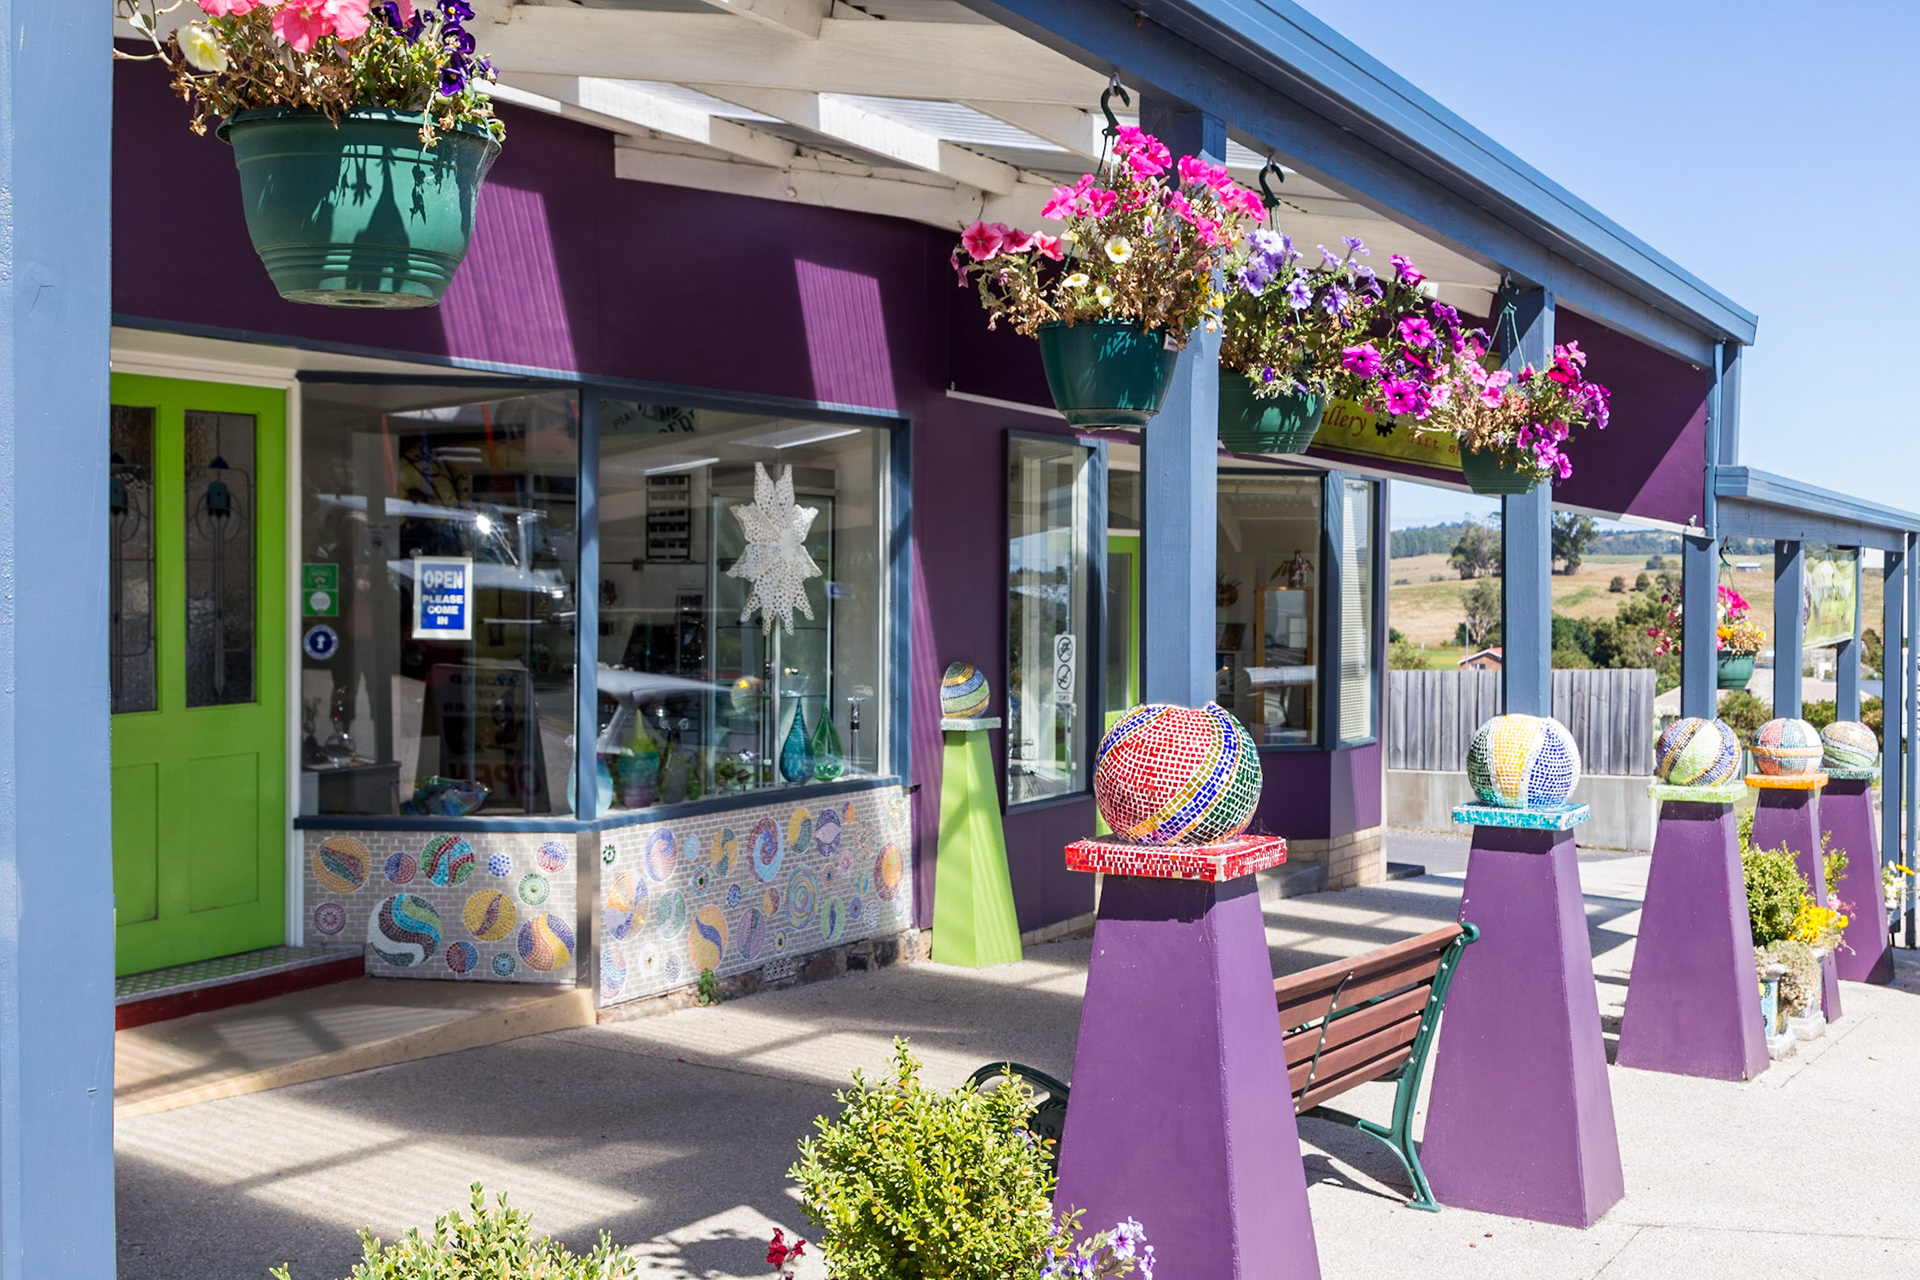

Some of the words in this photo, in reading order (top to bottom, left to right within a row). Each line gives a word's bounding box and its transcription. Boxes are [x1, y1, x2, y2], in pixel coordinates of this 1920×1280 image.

[1407, 432, 1439, 450] Gift
[423, 570, 464, 589] OPEN
[422, 594, 464, 604] PLEASE
[427, 605, 459, 615] COME
[436, 616, 449, 625] IN
